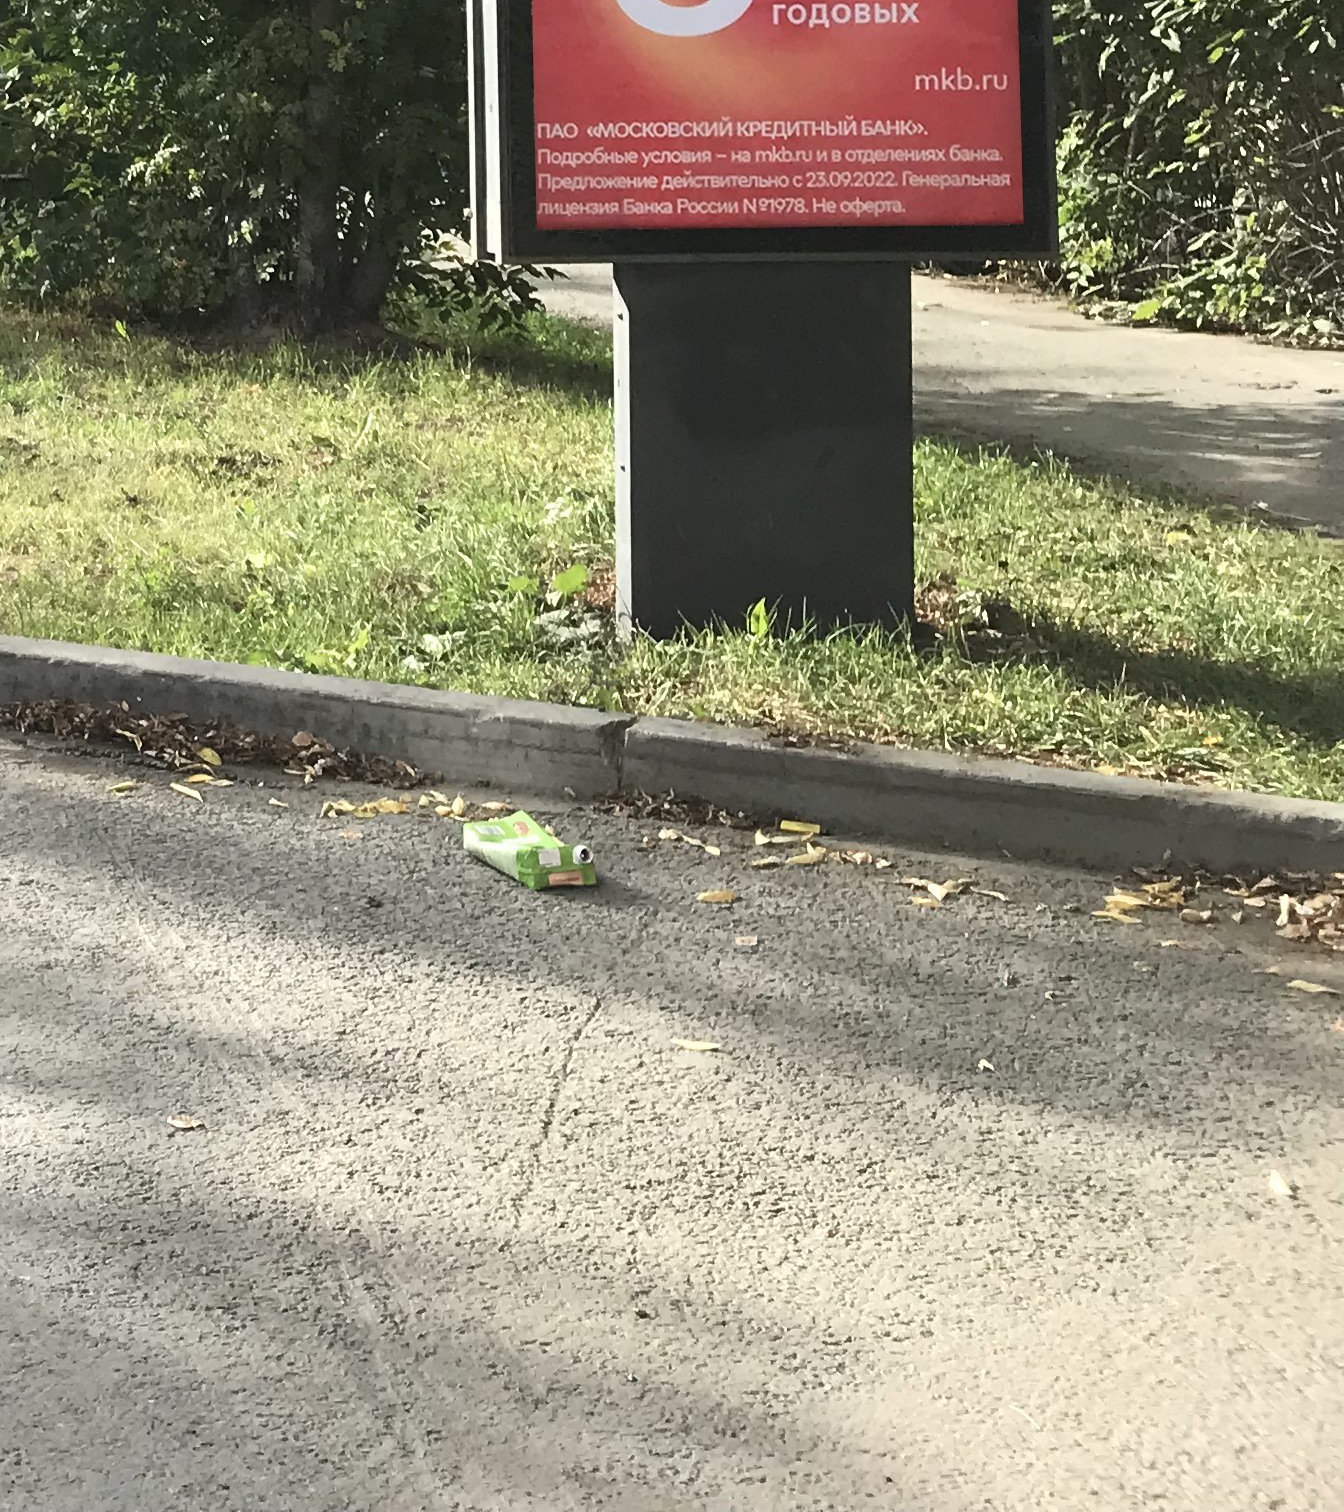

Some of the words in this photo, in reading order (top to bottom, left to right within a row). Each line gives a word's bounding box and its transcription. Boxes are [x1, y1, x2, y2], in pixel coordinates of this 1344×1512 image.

[772, 2, 920, 29] годовых
[914, 67, 1009, 90] mkb.ru
[536, 122, 579, 138] ПАО
[586, 116, 733, 138] «МОСКОВСКИЙ
[737, 115, 857, 140] КРЕДИТНЫЙ
[861, 120, 928, 136] БАНК».
[537, 146, 638, 168] Подробные
[641, 150, 712, 168] условия
[730, 151, 751, 163] на
[755, 145, 813, 163] mkb.ru
[816, 150, 828, 162] и
[831, 150, 841, 162] в
[845, 147, 945, 164] отделениях
[949, 144, 1003, 162] банка.
[537, 173, 658, 192] Предложение
[661, 170, 789, 191] действительно
[792, 176, 803, 187] с
[902, 171, 1011, 189] Генеральная
[536, 200, 620, 217] лицензия
[623, 198, 673, 215] Банка
[677, 198, 739, 215] России
[813, 198, 836, 213] Не
[840, 197, 906, 217] оферта.
